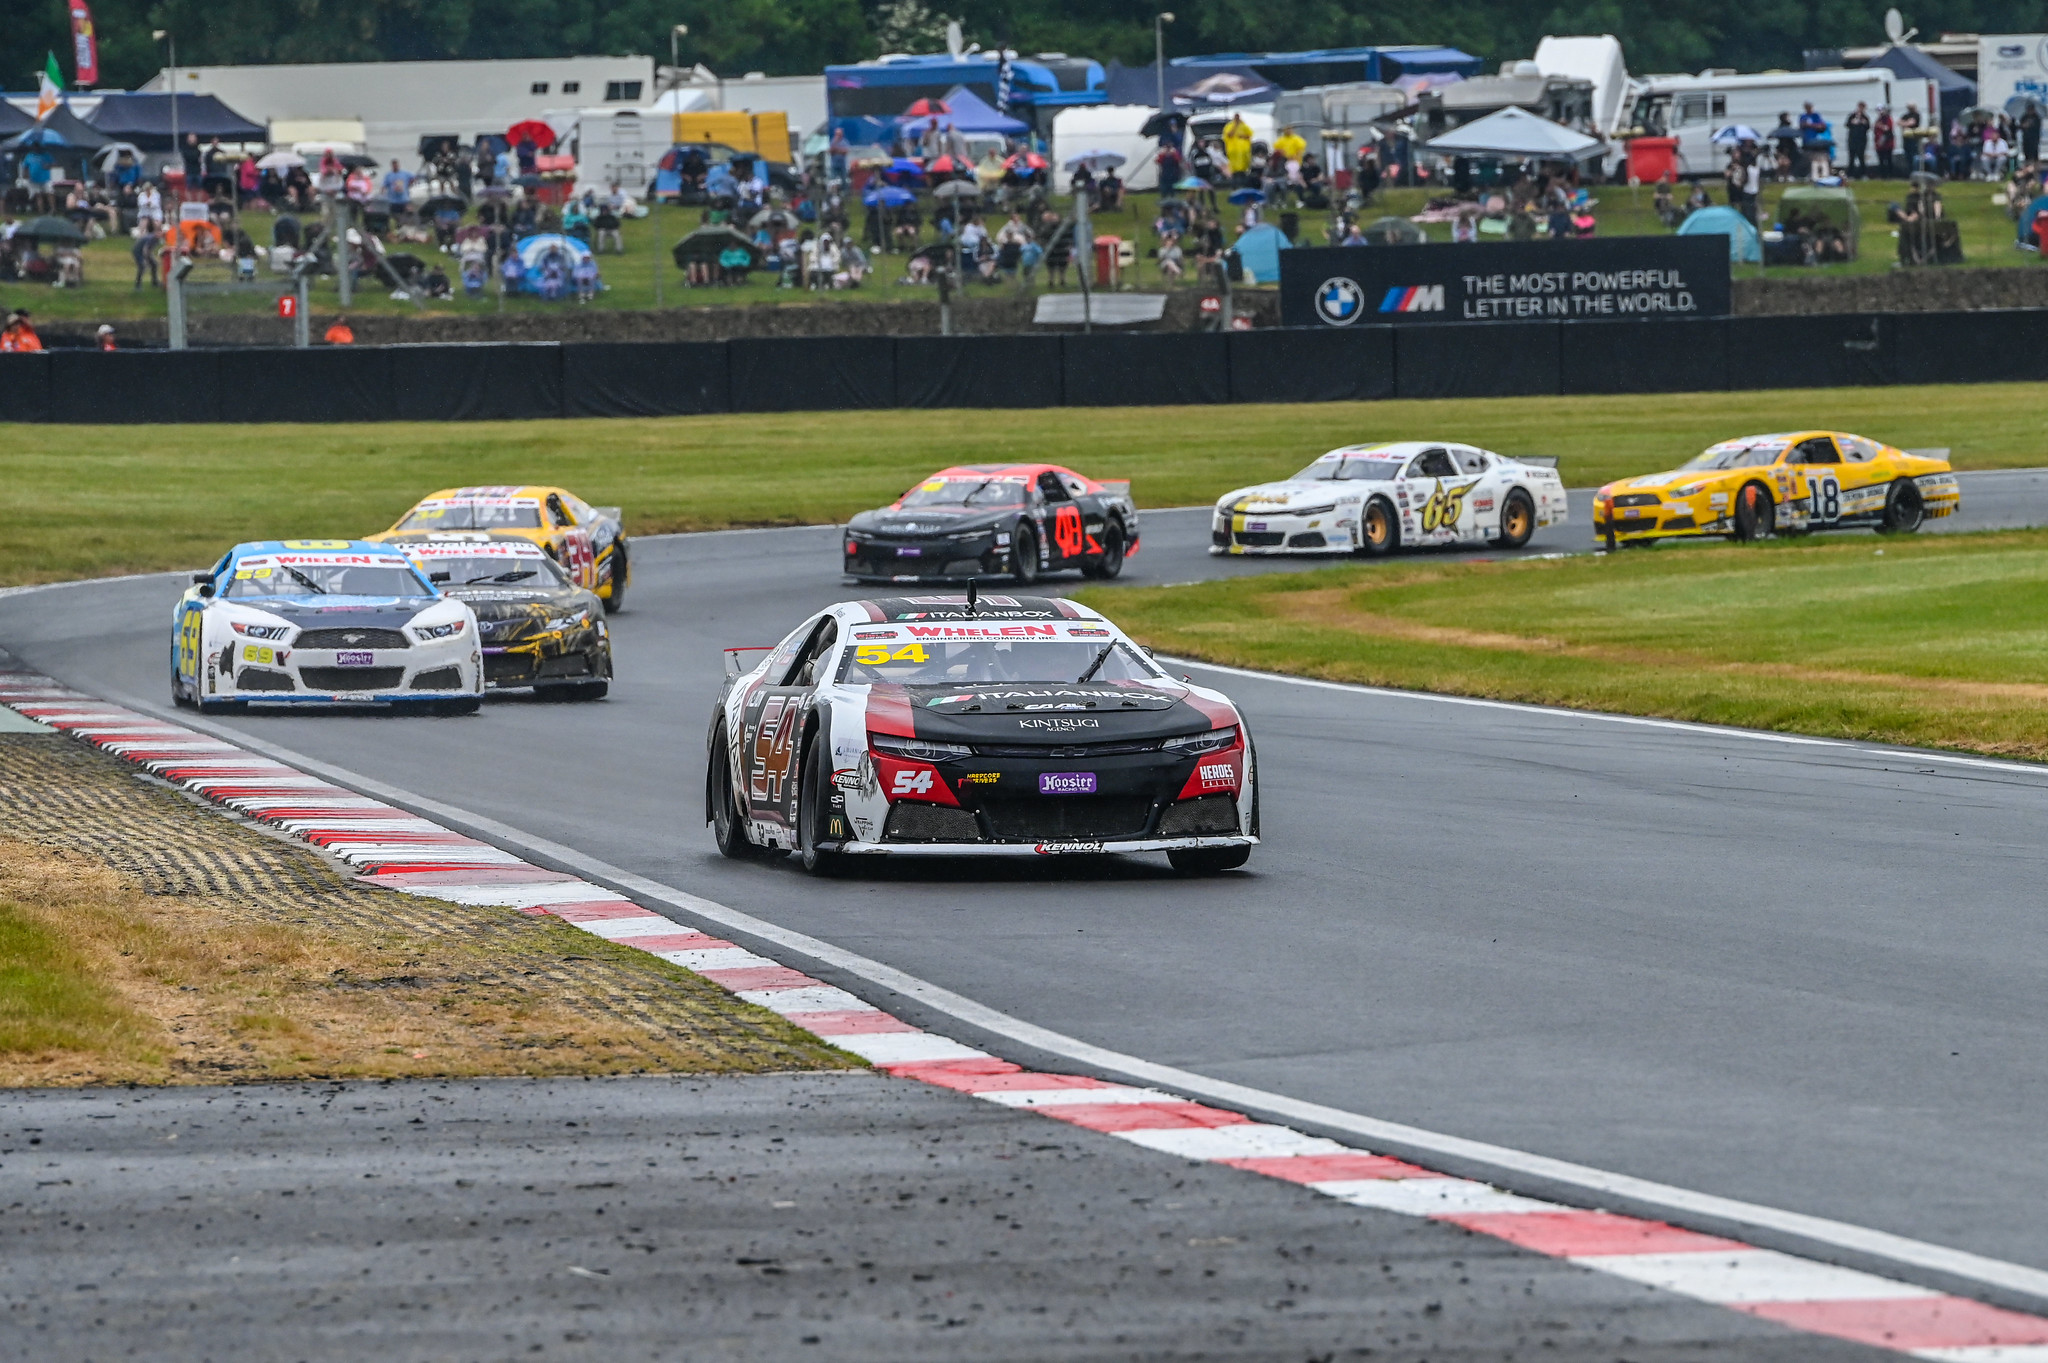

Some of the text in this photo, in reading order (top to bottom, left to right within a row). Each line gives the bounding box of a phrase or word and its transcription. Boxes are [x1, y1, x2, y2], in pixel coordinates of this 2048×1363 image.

[1462, 269, 1688, 295] THE MOST POWERFUL
[1463, 291, 1698, 318] LETTER IN THE WORLD.
[1807, 477, 1841, 521] 18
[1420, 482, 1474, 534] 65
[417, 547, 508, 555] WHELEN
[275, 556, 371, 565] WHELEN
[235, 568, 273, 580] 69
[929, 610, 1054, 619] ITALIANBOX
[905, 624, 1058, 637] WHELEN
[180, 609, 200, 678] 69
[243, 645, 274, 664] 69
[855, 643, 931, 665] 54
[978, 690, 1172, 703] ITALIANBOX
[1019, 718, 1100, 728] KINTSUGI
[750, 695, 801, 803] 54
[1199, 764, 1234, 780] HEROES
[891, 771, 934, 793] 54
[1041, 774, 1093, 790] Hoosier
[1040, 842, 1101, 852] KENNOL
